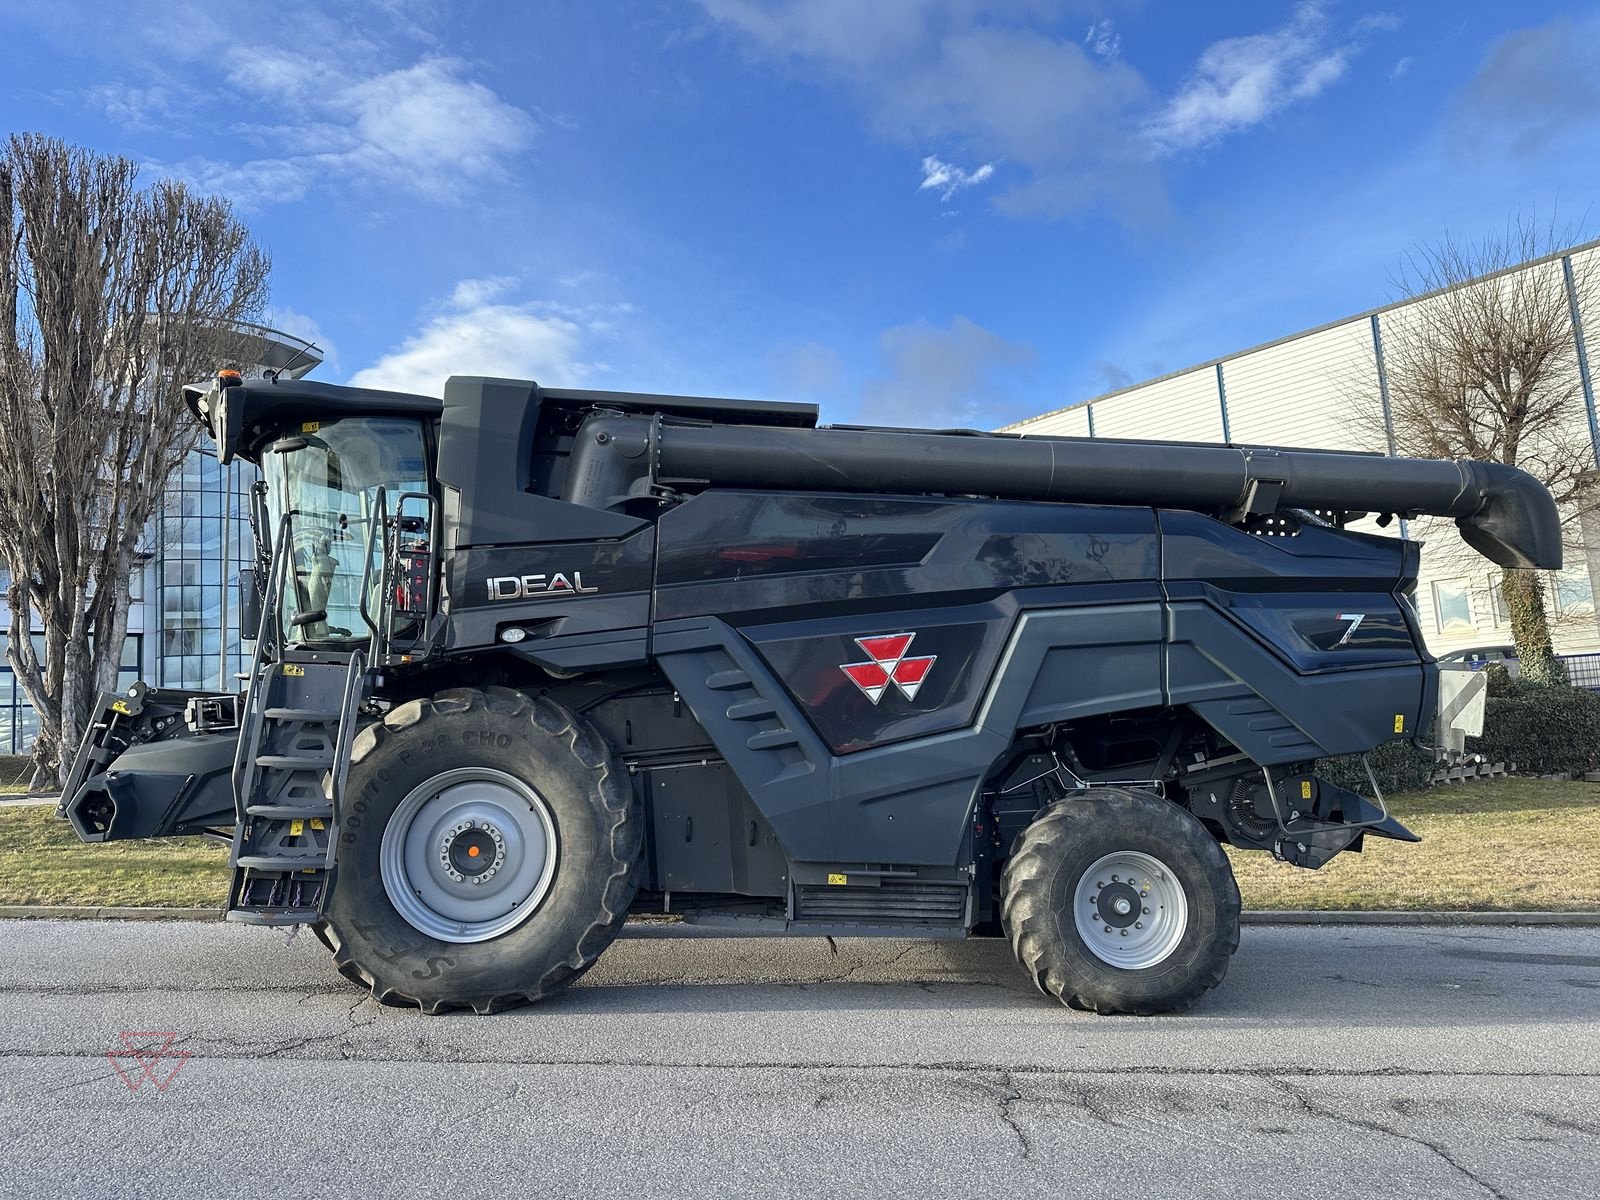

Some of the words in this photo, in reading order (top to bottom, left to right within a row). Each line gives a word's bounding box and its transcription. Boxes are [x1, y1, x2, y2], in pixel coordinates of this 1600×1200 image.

[486, 571, 599, 600] IDEAL
[1335, 613, 1366, 644] 7
[341, 767, 391, 844] 800/70
